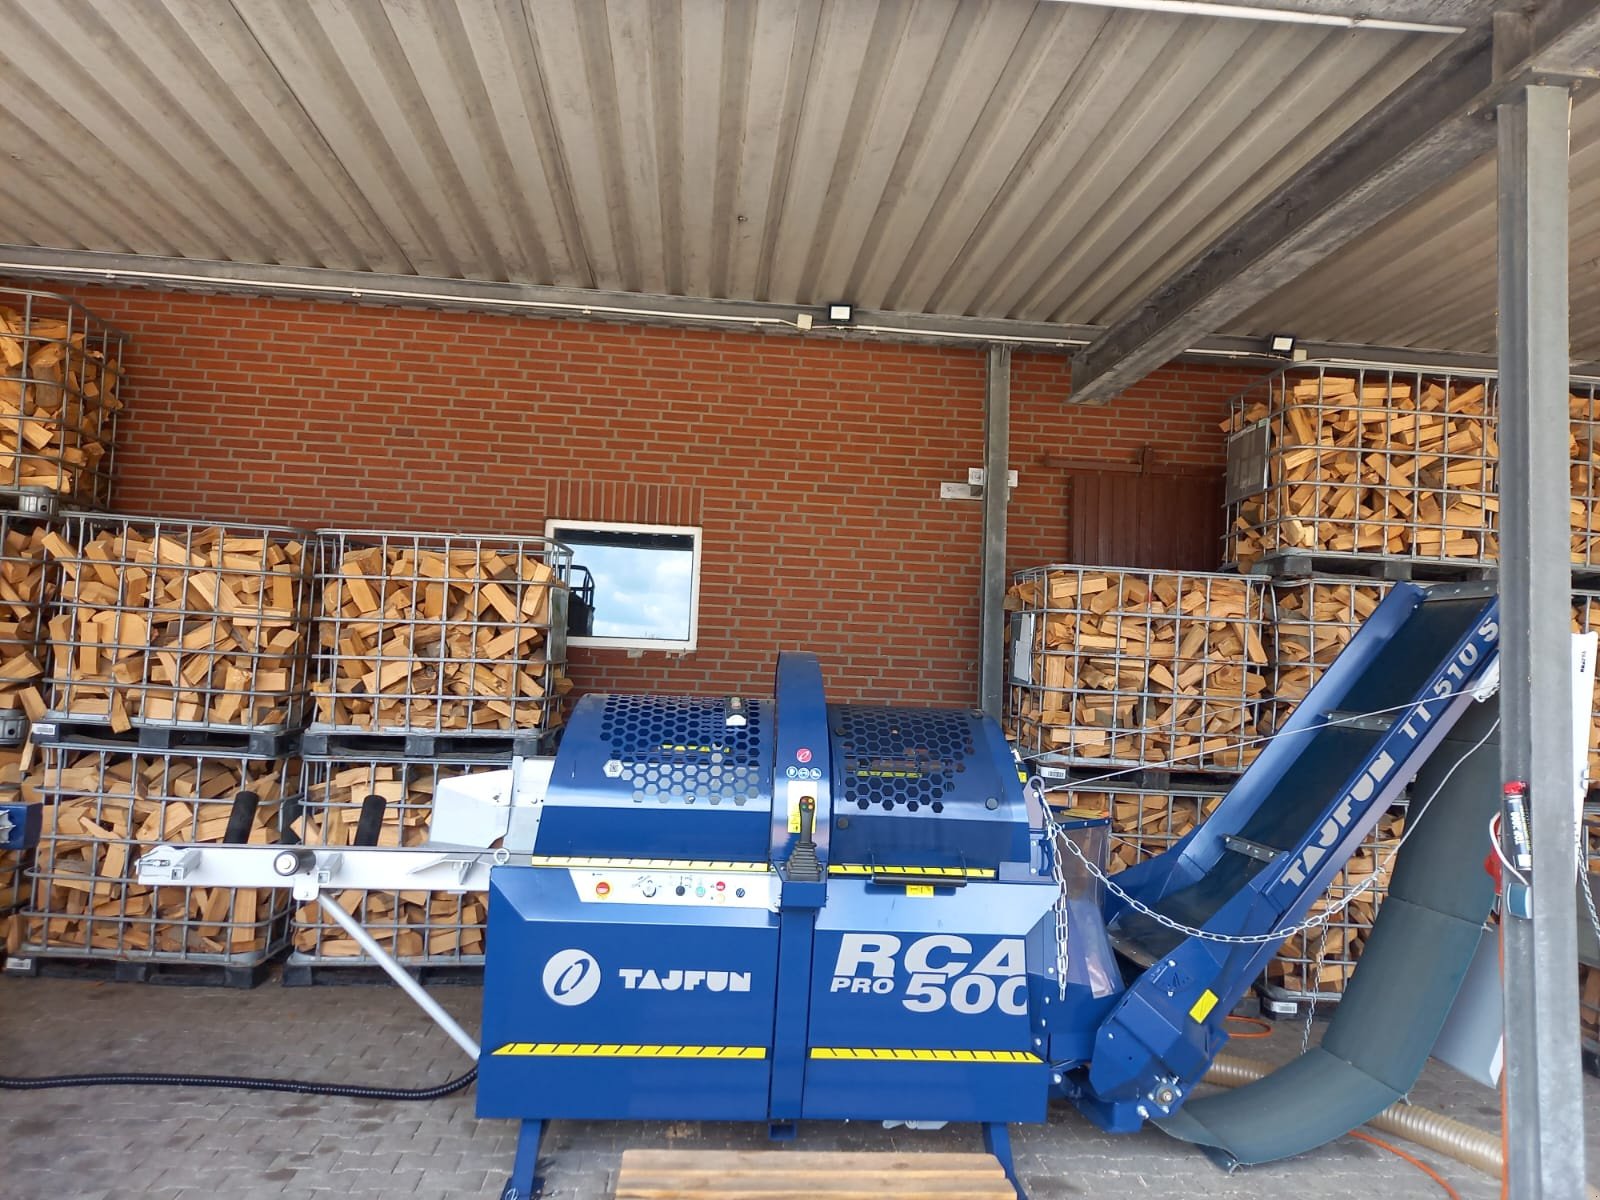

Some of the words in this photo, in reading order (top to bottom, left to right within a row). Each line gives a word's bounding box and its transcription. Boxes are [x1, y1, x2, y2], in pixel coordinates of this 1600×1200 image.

[1281, 750, 1395, 886] TAJFUN
[1398, 700, 1431, 739] TT
[1433, 642, 1478, 698] 510
[1478, 617, 1498, 641] S
[1513, 830, 1525, 845] TOP
[834, 933, 1026, 978] RCA
[619, 968, 752, 992] TAJFUN
[830, 977, 895, 994] PRO
